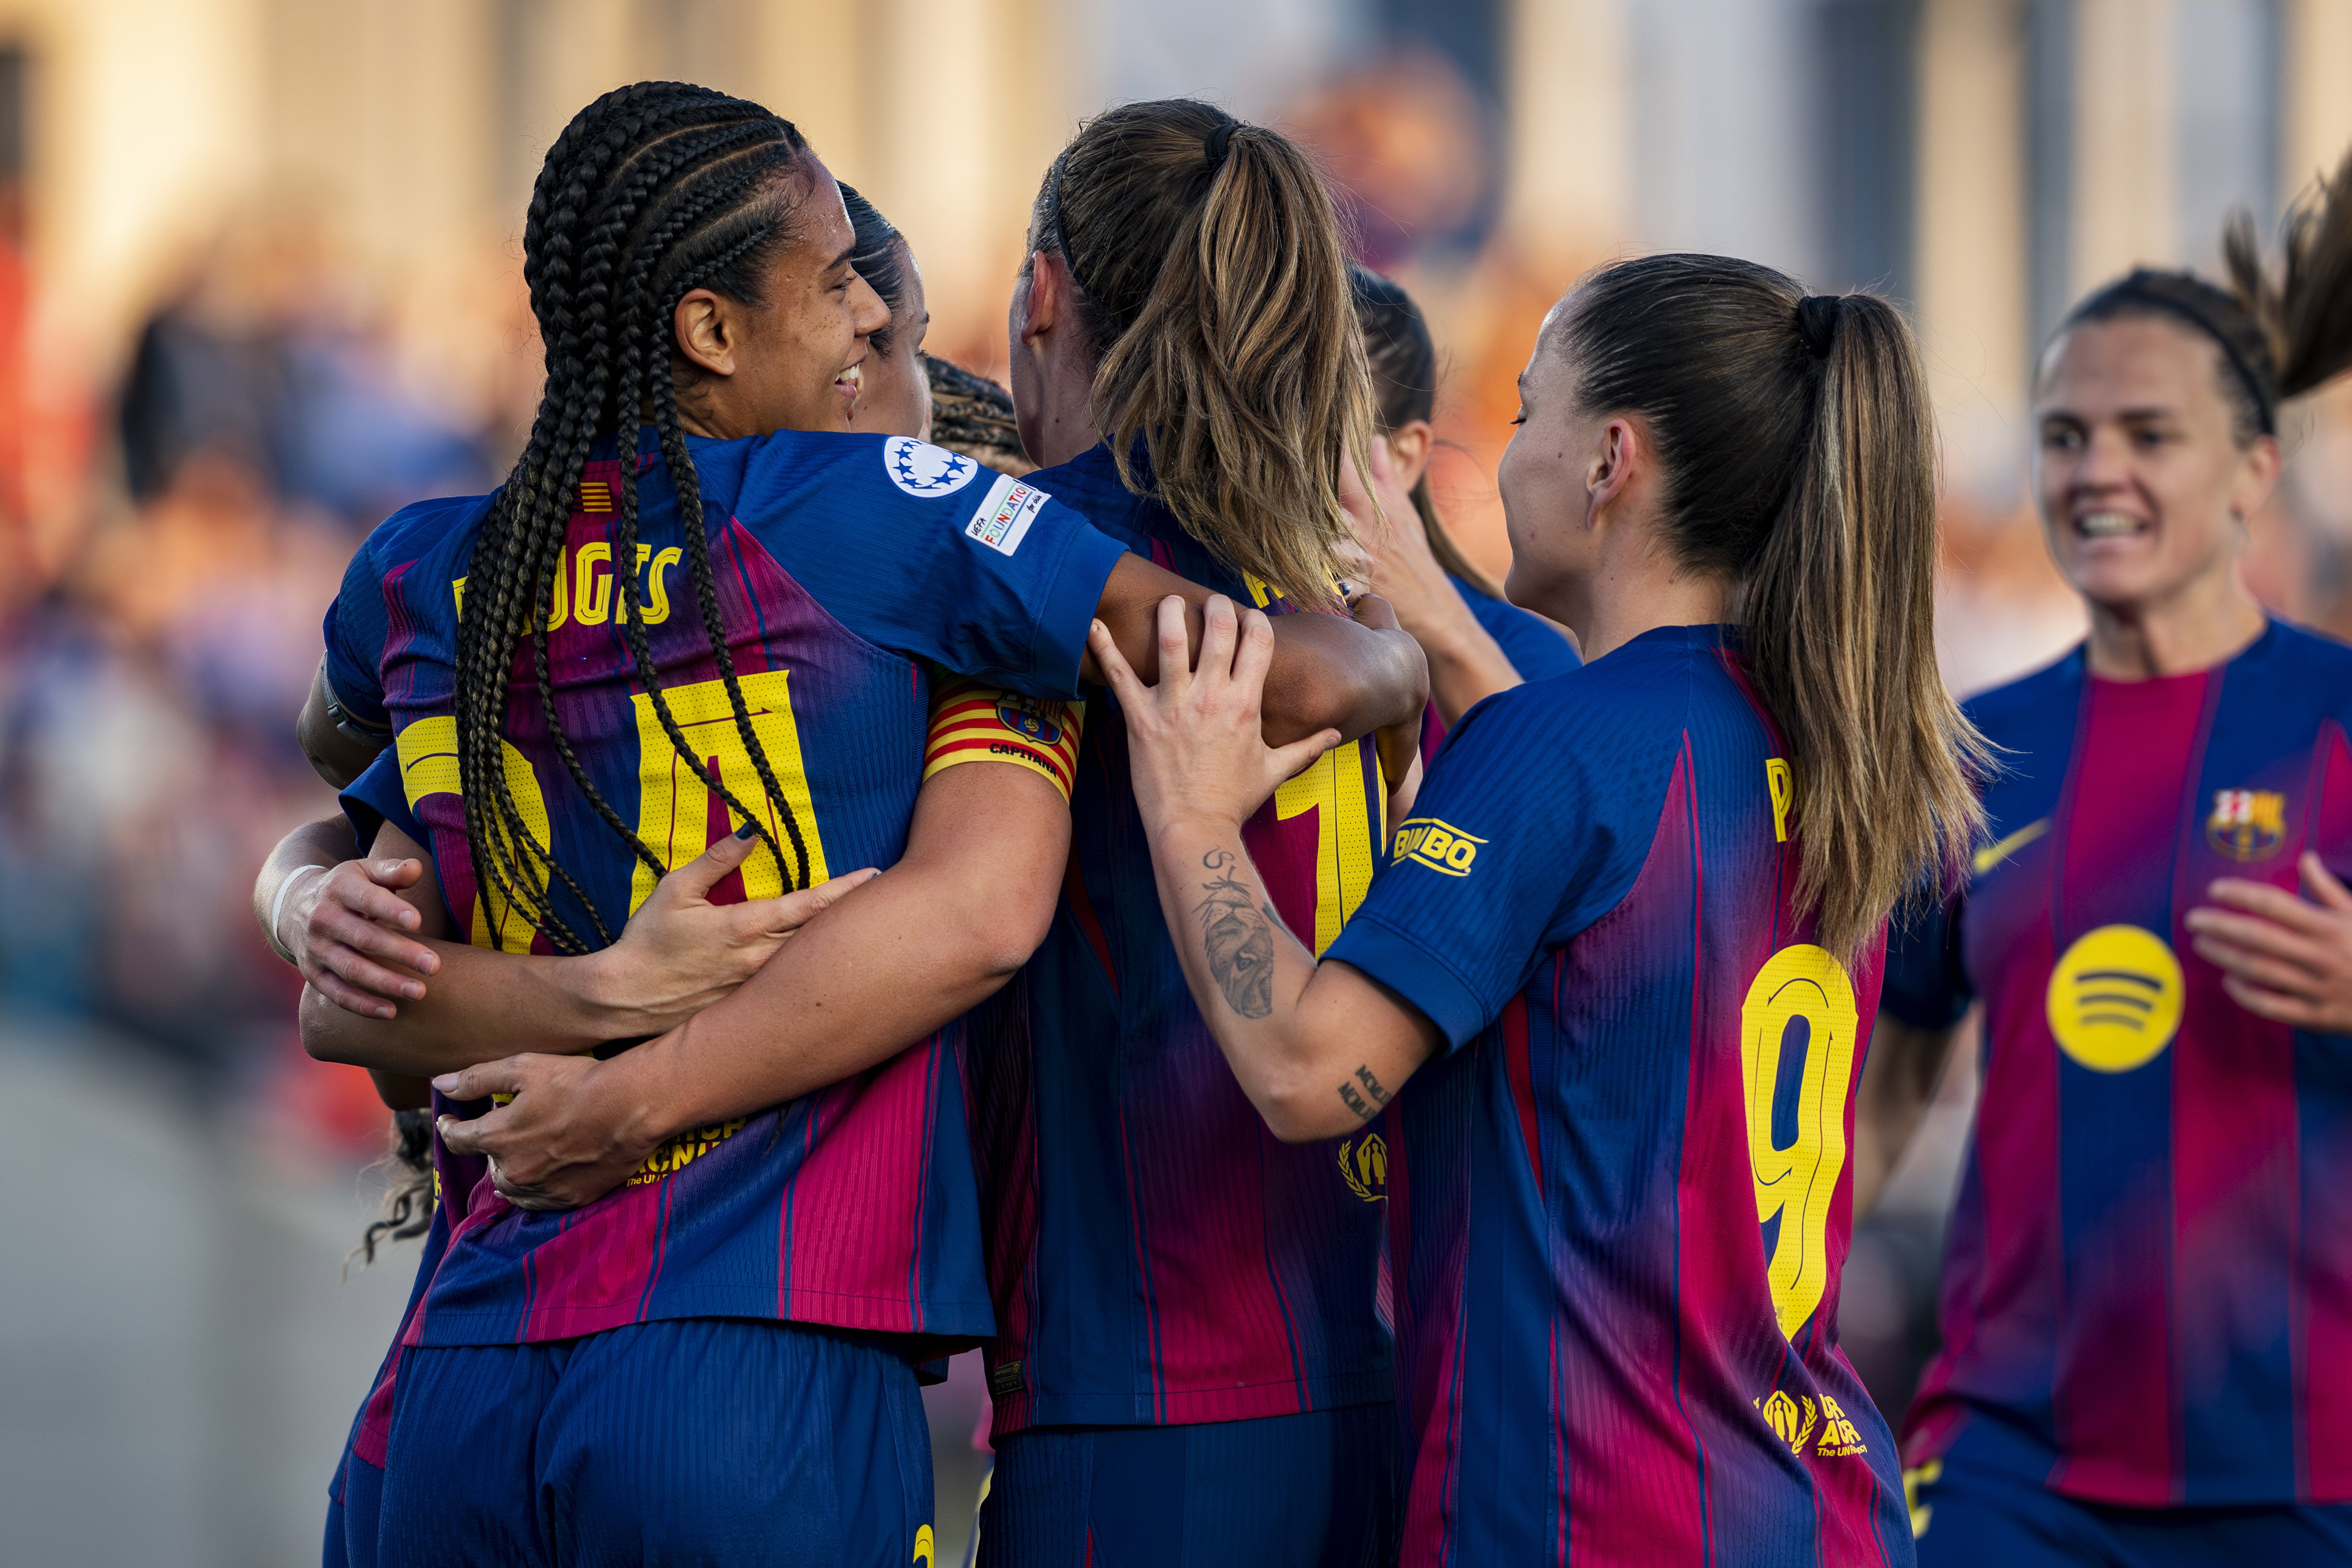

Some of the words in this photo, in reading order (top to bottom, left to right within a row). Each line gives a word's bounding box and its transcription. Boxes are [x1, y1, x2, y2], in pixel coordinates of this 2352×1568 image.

[971, 517, 986, 536] UEFA
[989, 743, 1057, 778] CAPITANA
[1741, 944, 1859, 1343] 9
[627, 1177, 642, 1187] The
[1817, 1448, 1836, 1457] The
